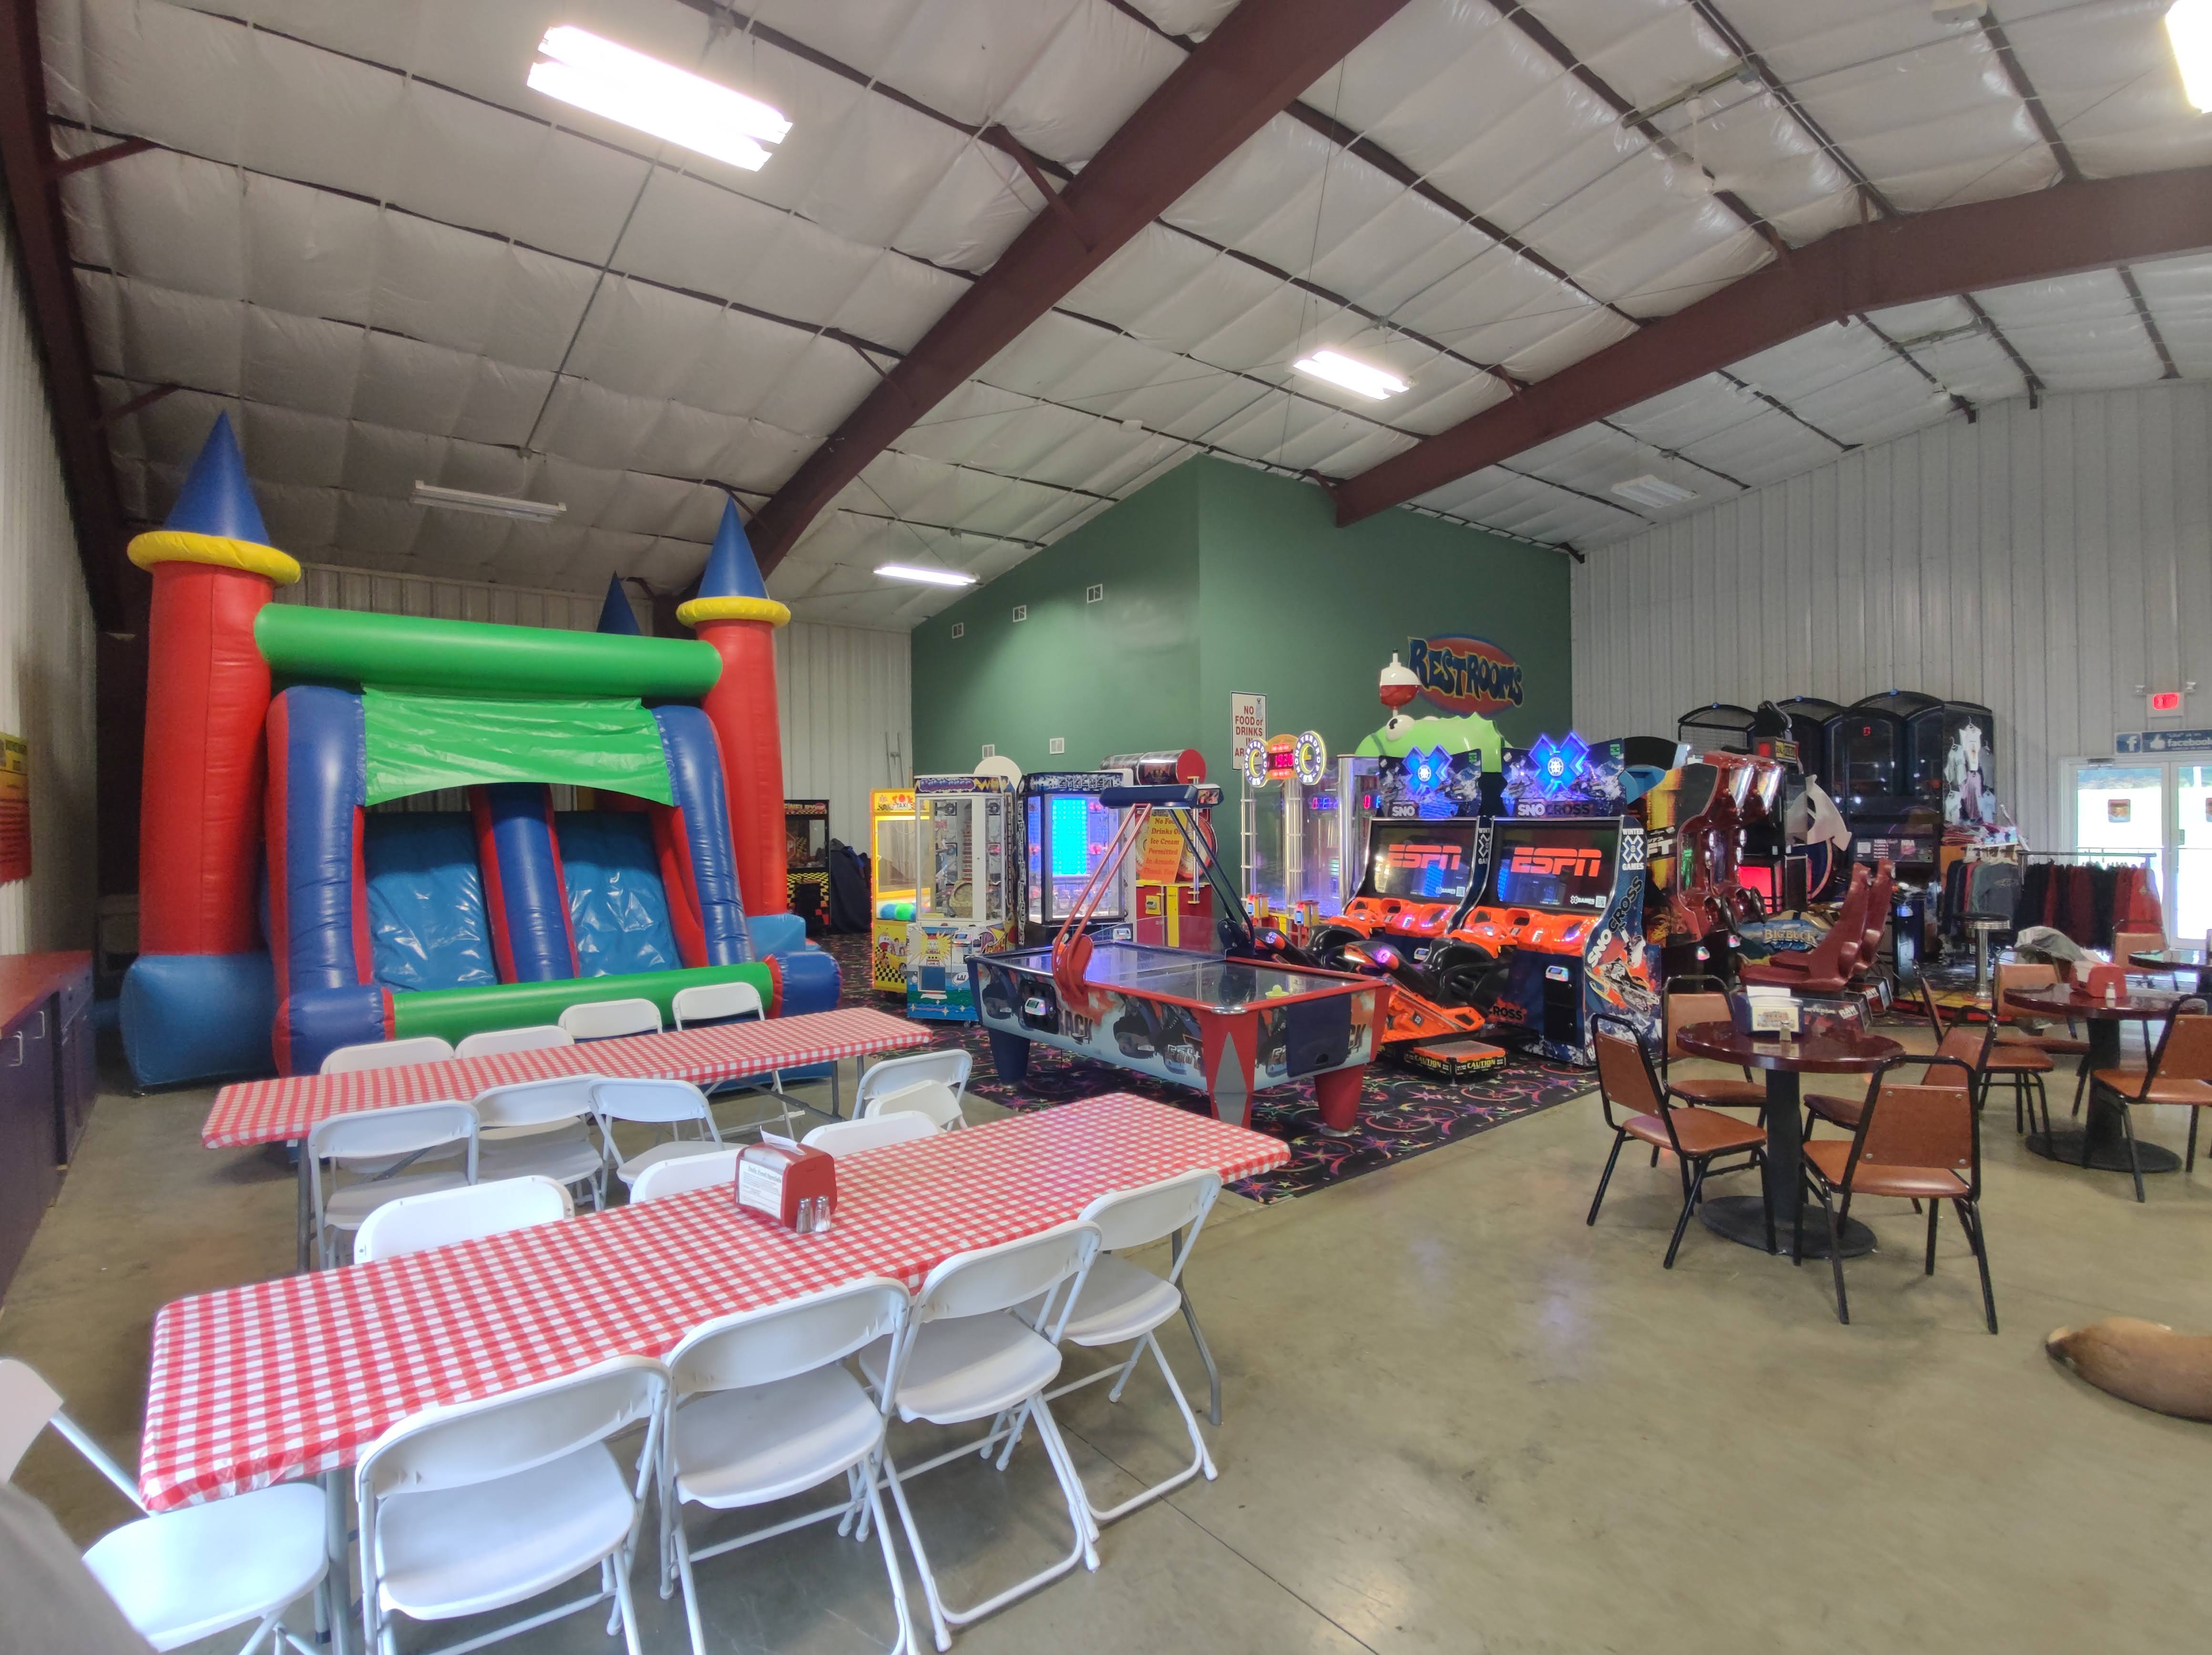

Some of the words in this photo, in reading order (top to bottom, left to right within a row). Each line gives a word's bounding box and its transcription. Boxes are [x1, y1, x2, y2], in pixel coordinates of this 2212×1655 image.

[1408, 636, 1524, 708] RESTROOMS
[1244, 705, 1254, 715] NO
[1235, 715, 1255, 725] FOOD
[1236, 726, 1262, 736] DRINKS
[1388, 844, 1462, 870] ESPN
[1510, 847, 1602, 877] ESPN
[1622, 862, 1644, 871] GAMES
[1764, 930, 1783, 940] BIG
[1414, 1054, 1441, 1068] CAUTION
[1467, 1059, 1495, 1069] CAUTION
